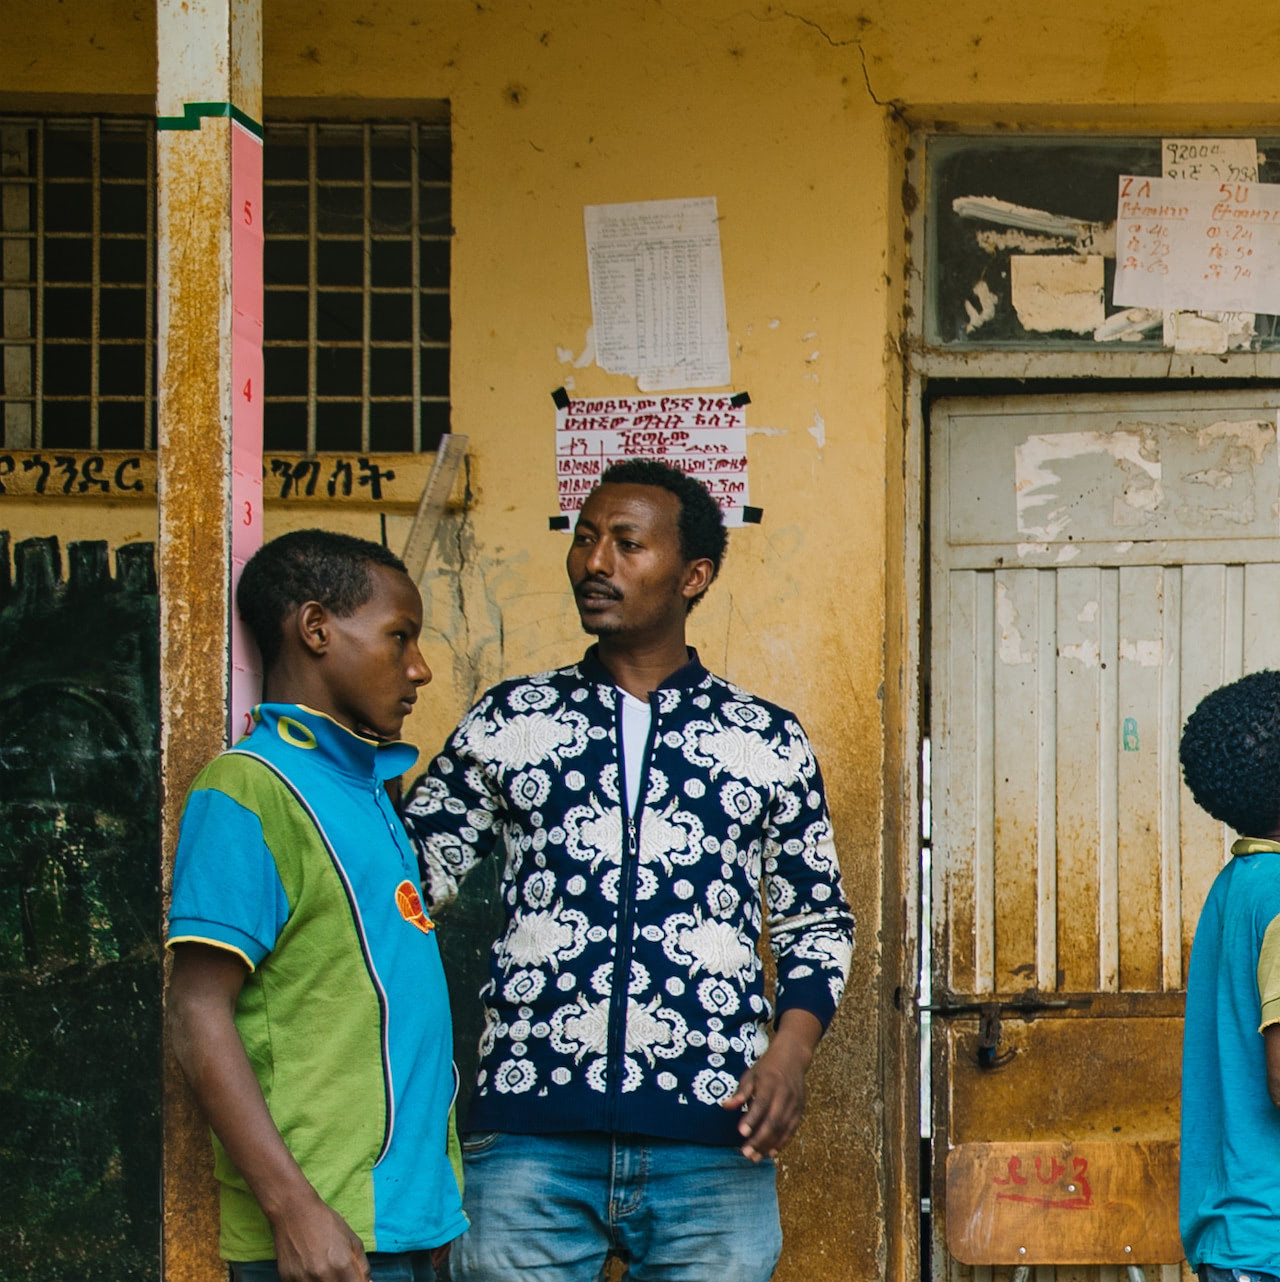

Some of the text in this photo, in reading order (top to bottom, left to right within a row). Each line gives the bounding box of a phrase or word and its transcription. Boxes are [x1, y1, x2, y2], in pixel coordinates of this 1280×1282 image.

[244, 200, 253, 226] 5
[243, 377, 253, 403] 4
[243, 500, 253, 526] 3
